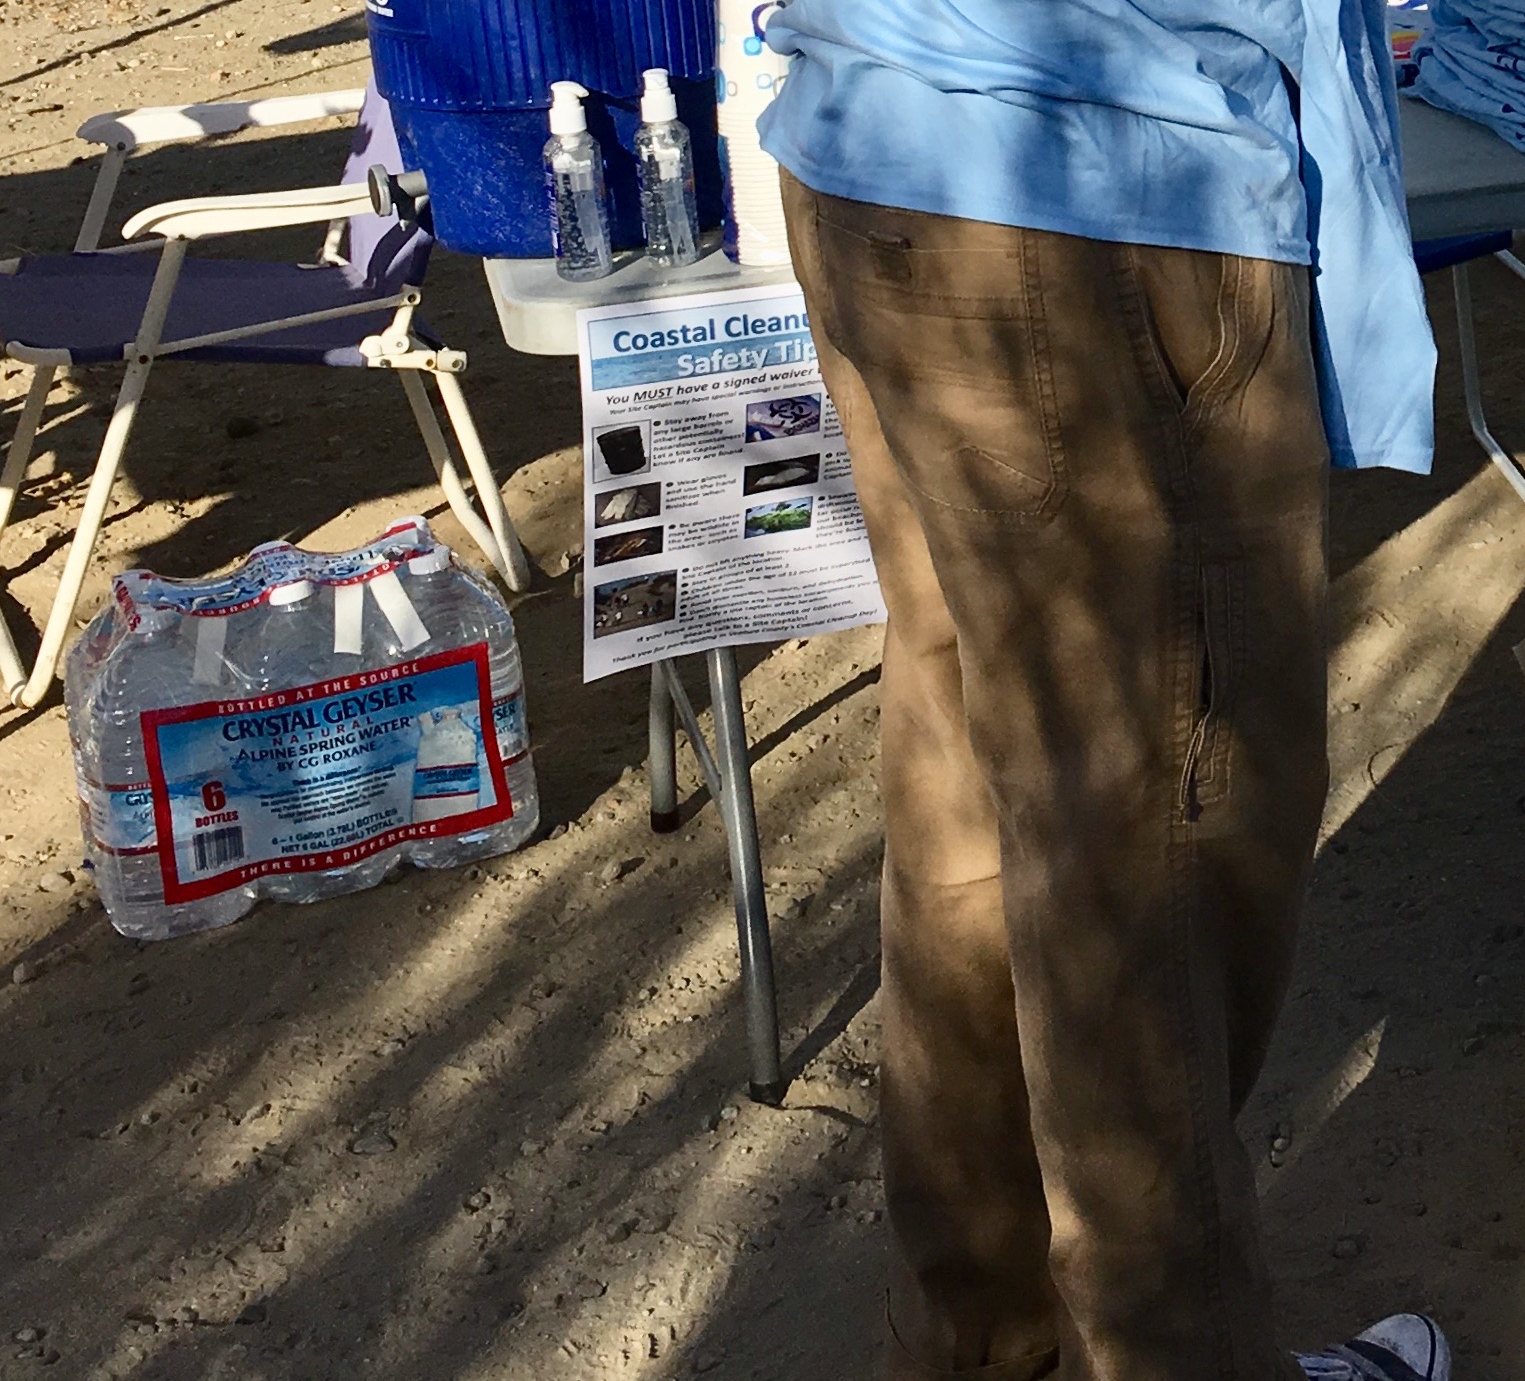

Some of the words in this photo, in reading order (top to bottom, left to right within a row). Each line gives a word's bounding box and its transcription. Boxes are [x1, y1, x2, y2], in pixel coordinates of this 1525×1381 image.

[613, 318, 715, 353] Coastal
[677, 347, 767, 377] Safety
[606, 395, 630, 405] You
[633, 386, 673, 403] MUST
[676, 382, 708, 396] have
[712, 381, 720, 390] a
[723, 373, 767, 389] signed
[770, 368, 813, 382] waiver
[644, 401, 672, 411] Captain
[674, 398, 690, 408] may
[218, 695, 286, 714] BOTTLED
[296, 690, 314, 701] AT
[324, 681, 350, 694] THE
[360, 663, 419, 686] SOURCE
[222, 708, 320, 741] CRYSTAL
[323, 682, 417, 724] GEYSER
[238, 746, 297, 763] ALPINE
[299, 732, 356, 756] SPRING
[358, 716, 410, 740] WATER
[272, 717, 375, 746] NATURAL
[277, 761, 294, 772] BY
[298, 757, 319, 769] CG
[323, 741, 377, 764] ROXANE
[202, 780, 227, 812] 6
[195, 811, 239, 828] BOTTLES
[296, 829, 325, 841] Gallon
[356, 808, 398, 828] BOTTLES
[310, 838, 330, 849] GAL
[365, 820, 394, 835] TOTAL
[241, 861, 291, 879] THERE
[302, 857, 315, 867] IS
[343, 824, 436, 860] DIFFERENCE
